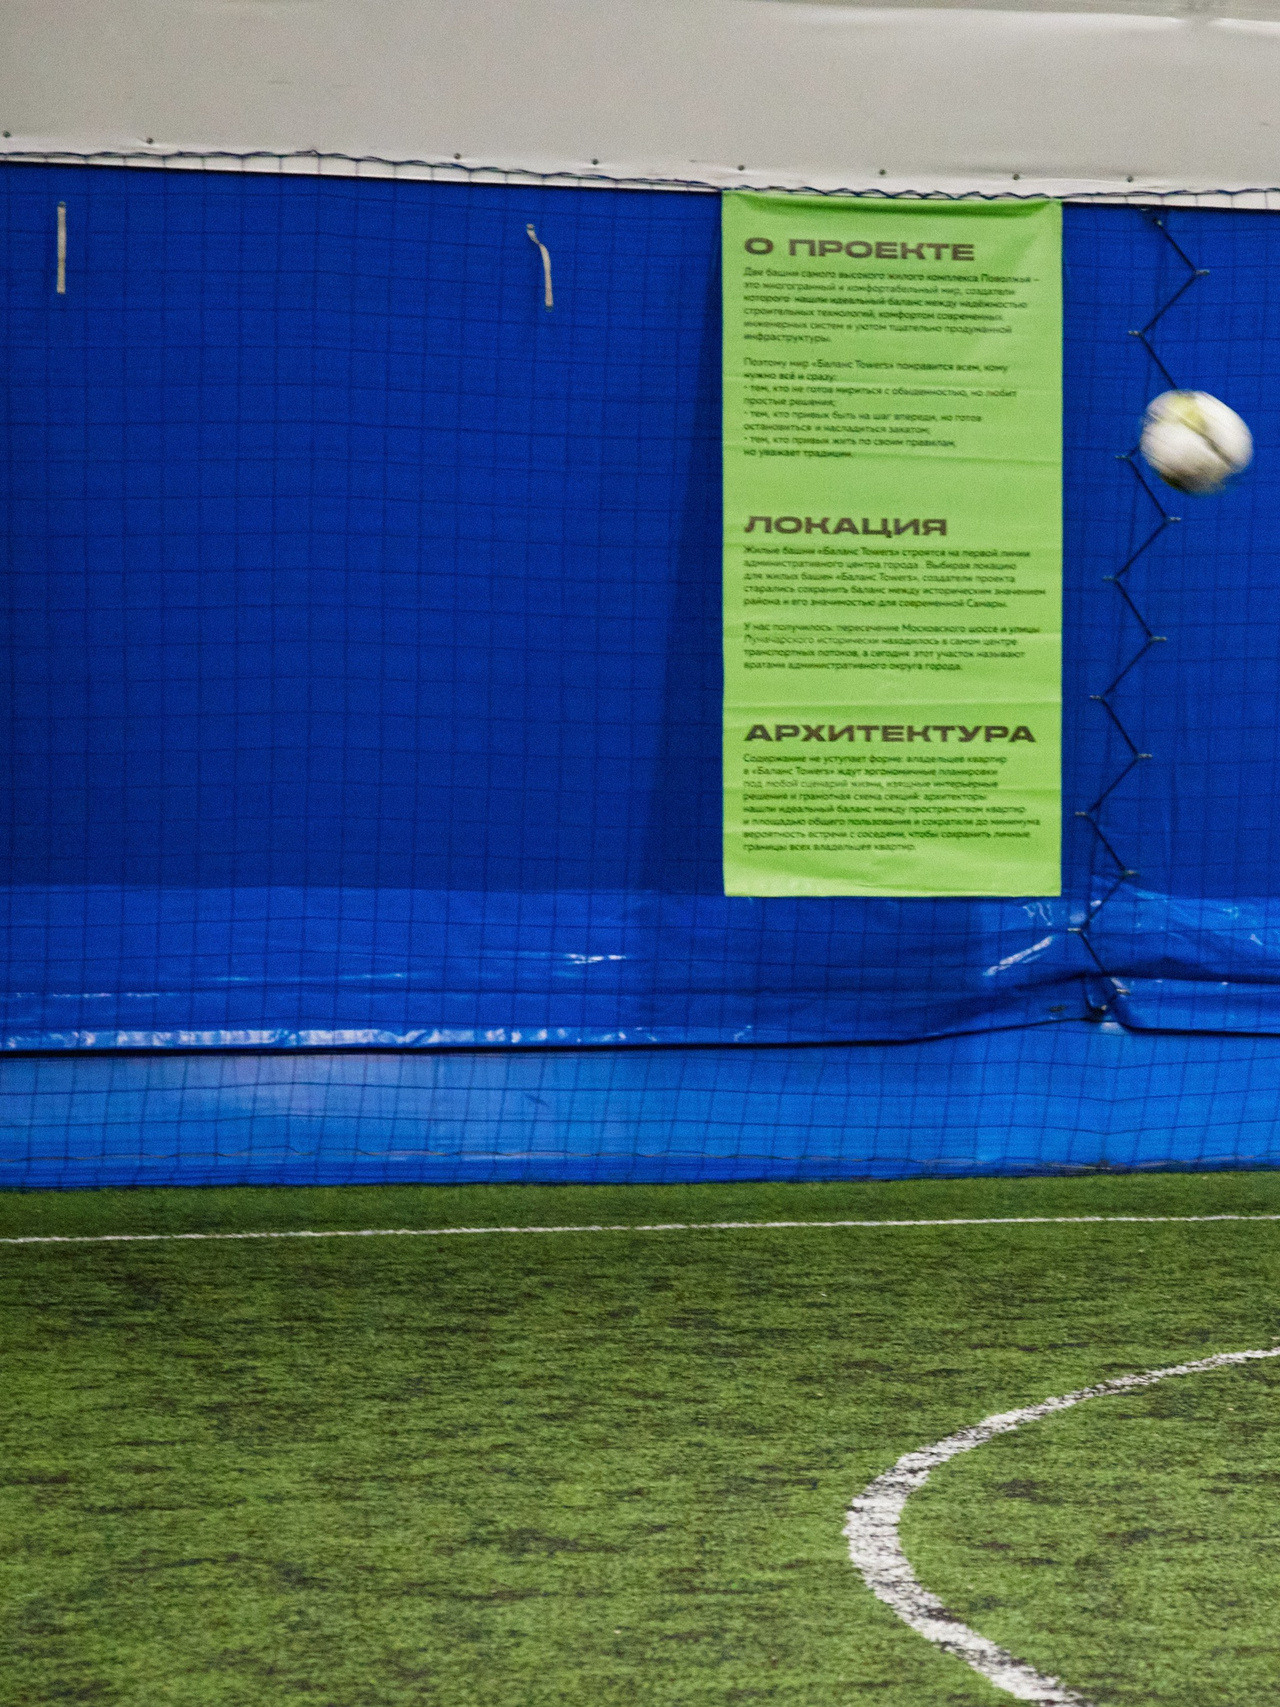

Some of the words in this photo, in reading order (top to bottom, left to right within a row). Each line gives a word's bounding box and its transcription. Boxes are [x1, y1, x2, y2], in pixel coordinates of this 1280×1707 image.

[744, 238, 774, 254] О
[788, 238, 974, 260] ПРОЕКТЕ
[744, 516, 946, 538] ЛОКАЦИЯ
[744, 724, 1036, 742] АРХИТЕКТУРА
